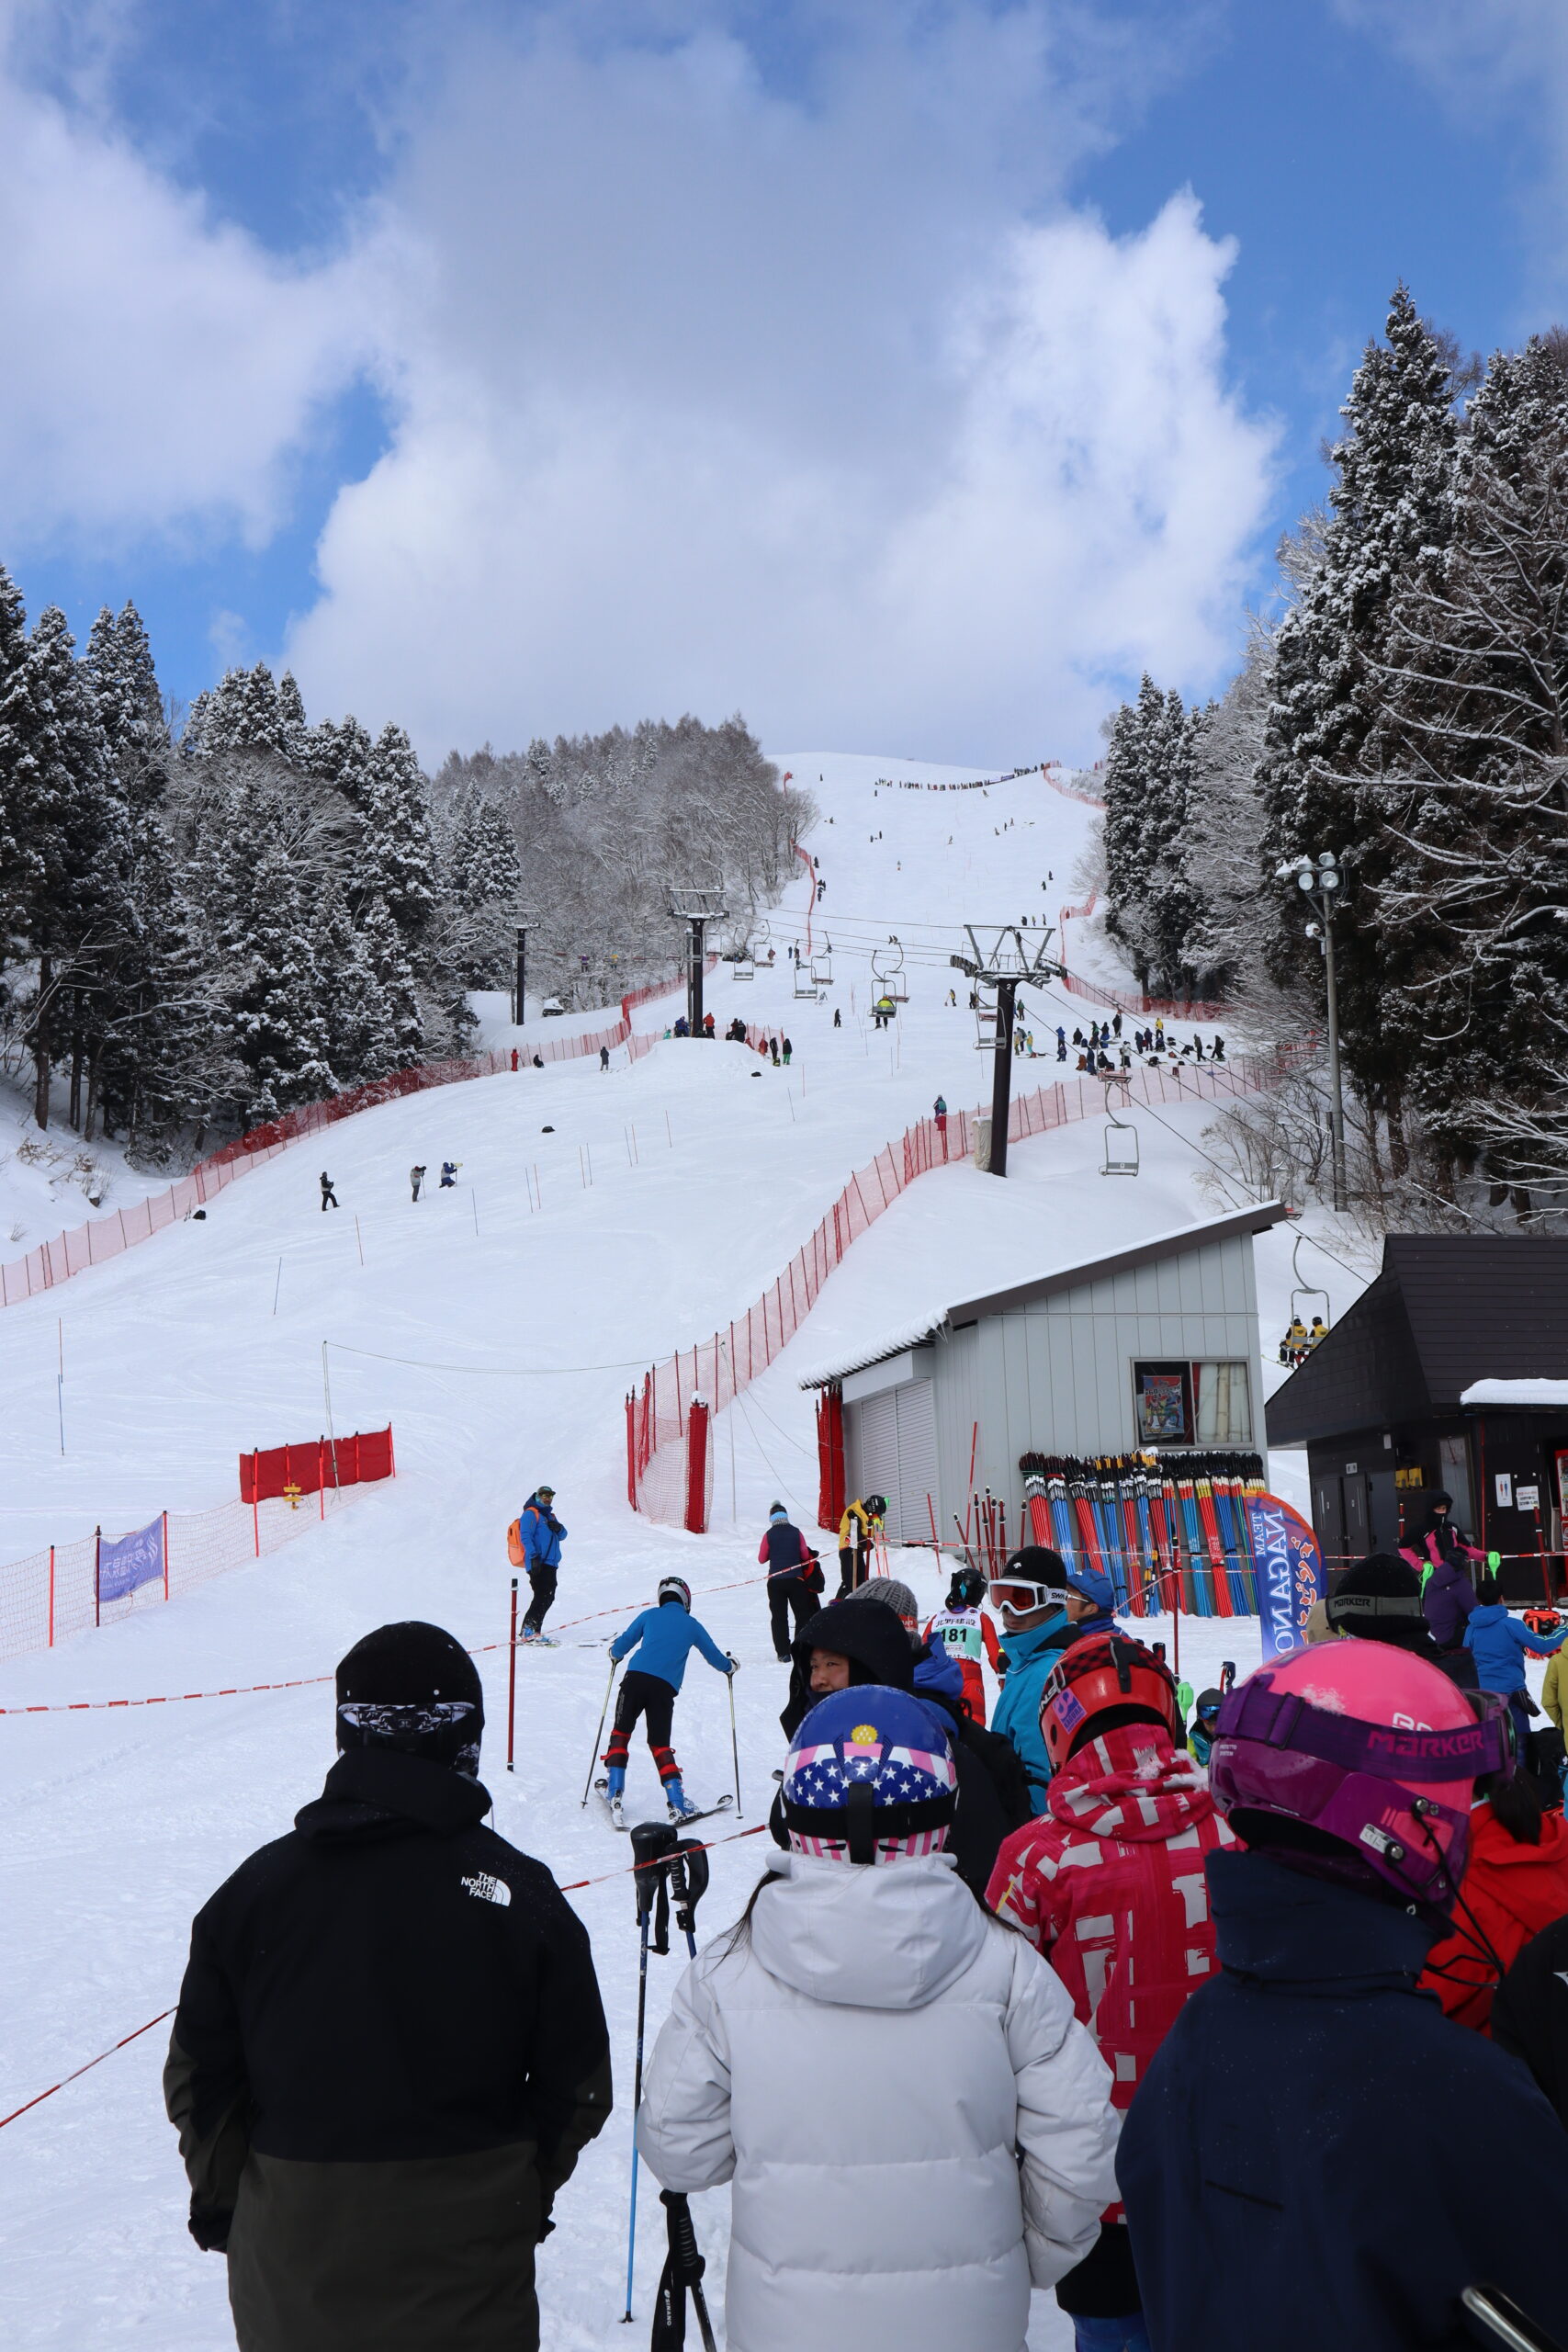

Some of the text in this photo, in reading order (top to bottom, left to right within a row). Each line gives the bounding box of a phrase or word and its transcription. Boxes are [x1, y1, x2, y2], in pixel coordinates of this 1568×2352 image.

[941, 1628, 967, 1643] 181
[460, 1876, 495, 1893] NORTH
[478, 1871, 497, 1884] THE
[469, 1887, 492, 1902] FACE
